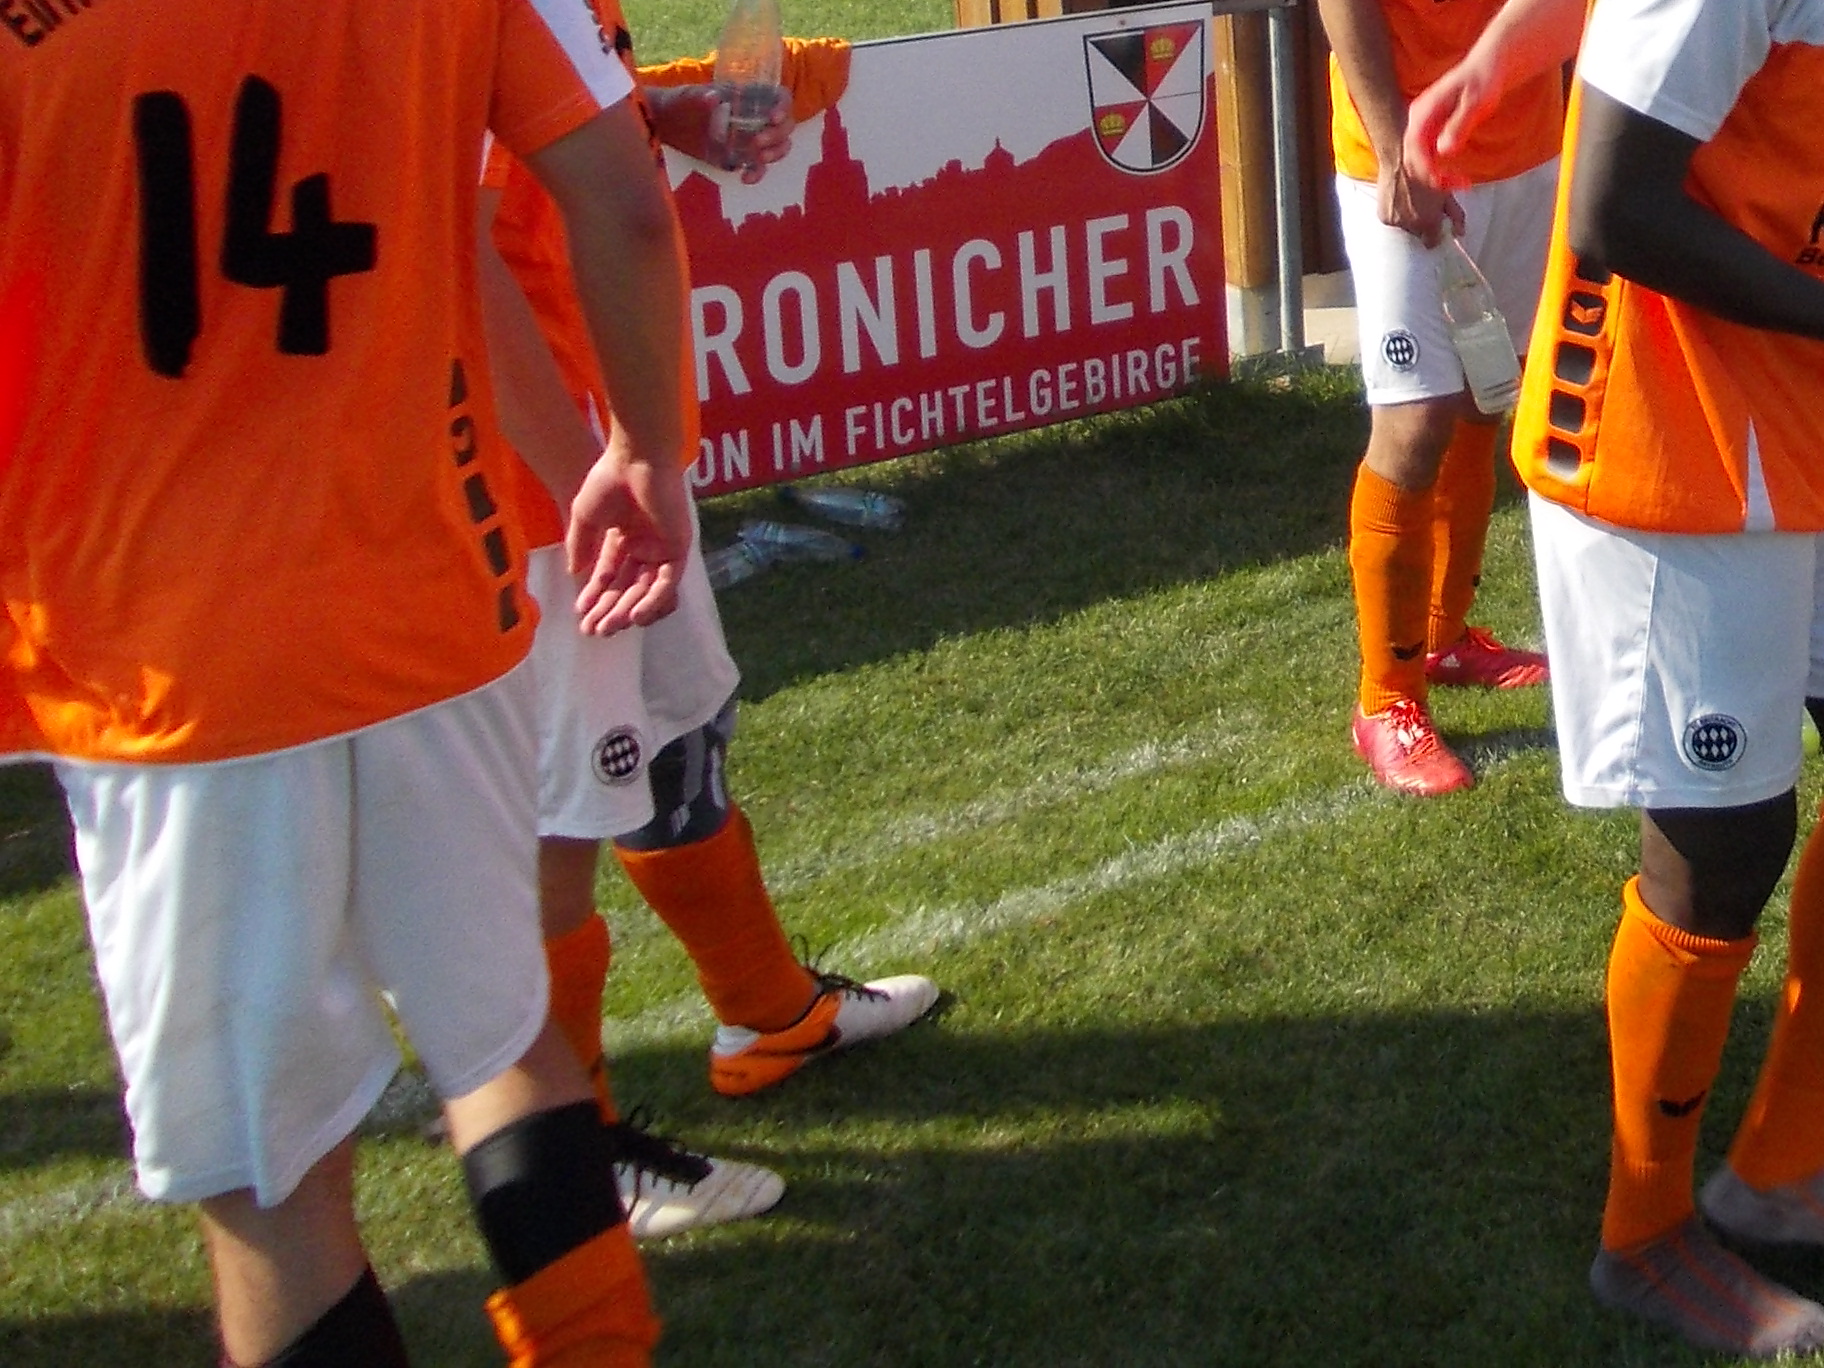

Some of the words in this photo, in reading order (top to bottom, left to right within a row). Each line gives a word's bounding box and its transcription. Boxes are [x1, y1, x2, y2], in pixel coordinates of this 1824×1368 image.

[132, 73, 378, 379] 14
[689, 205, 1201, 401] RONICHER
[772, 414, 825, 472] IM
[845, 337, 1202, 455] FICHTELGEBIRGE
